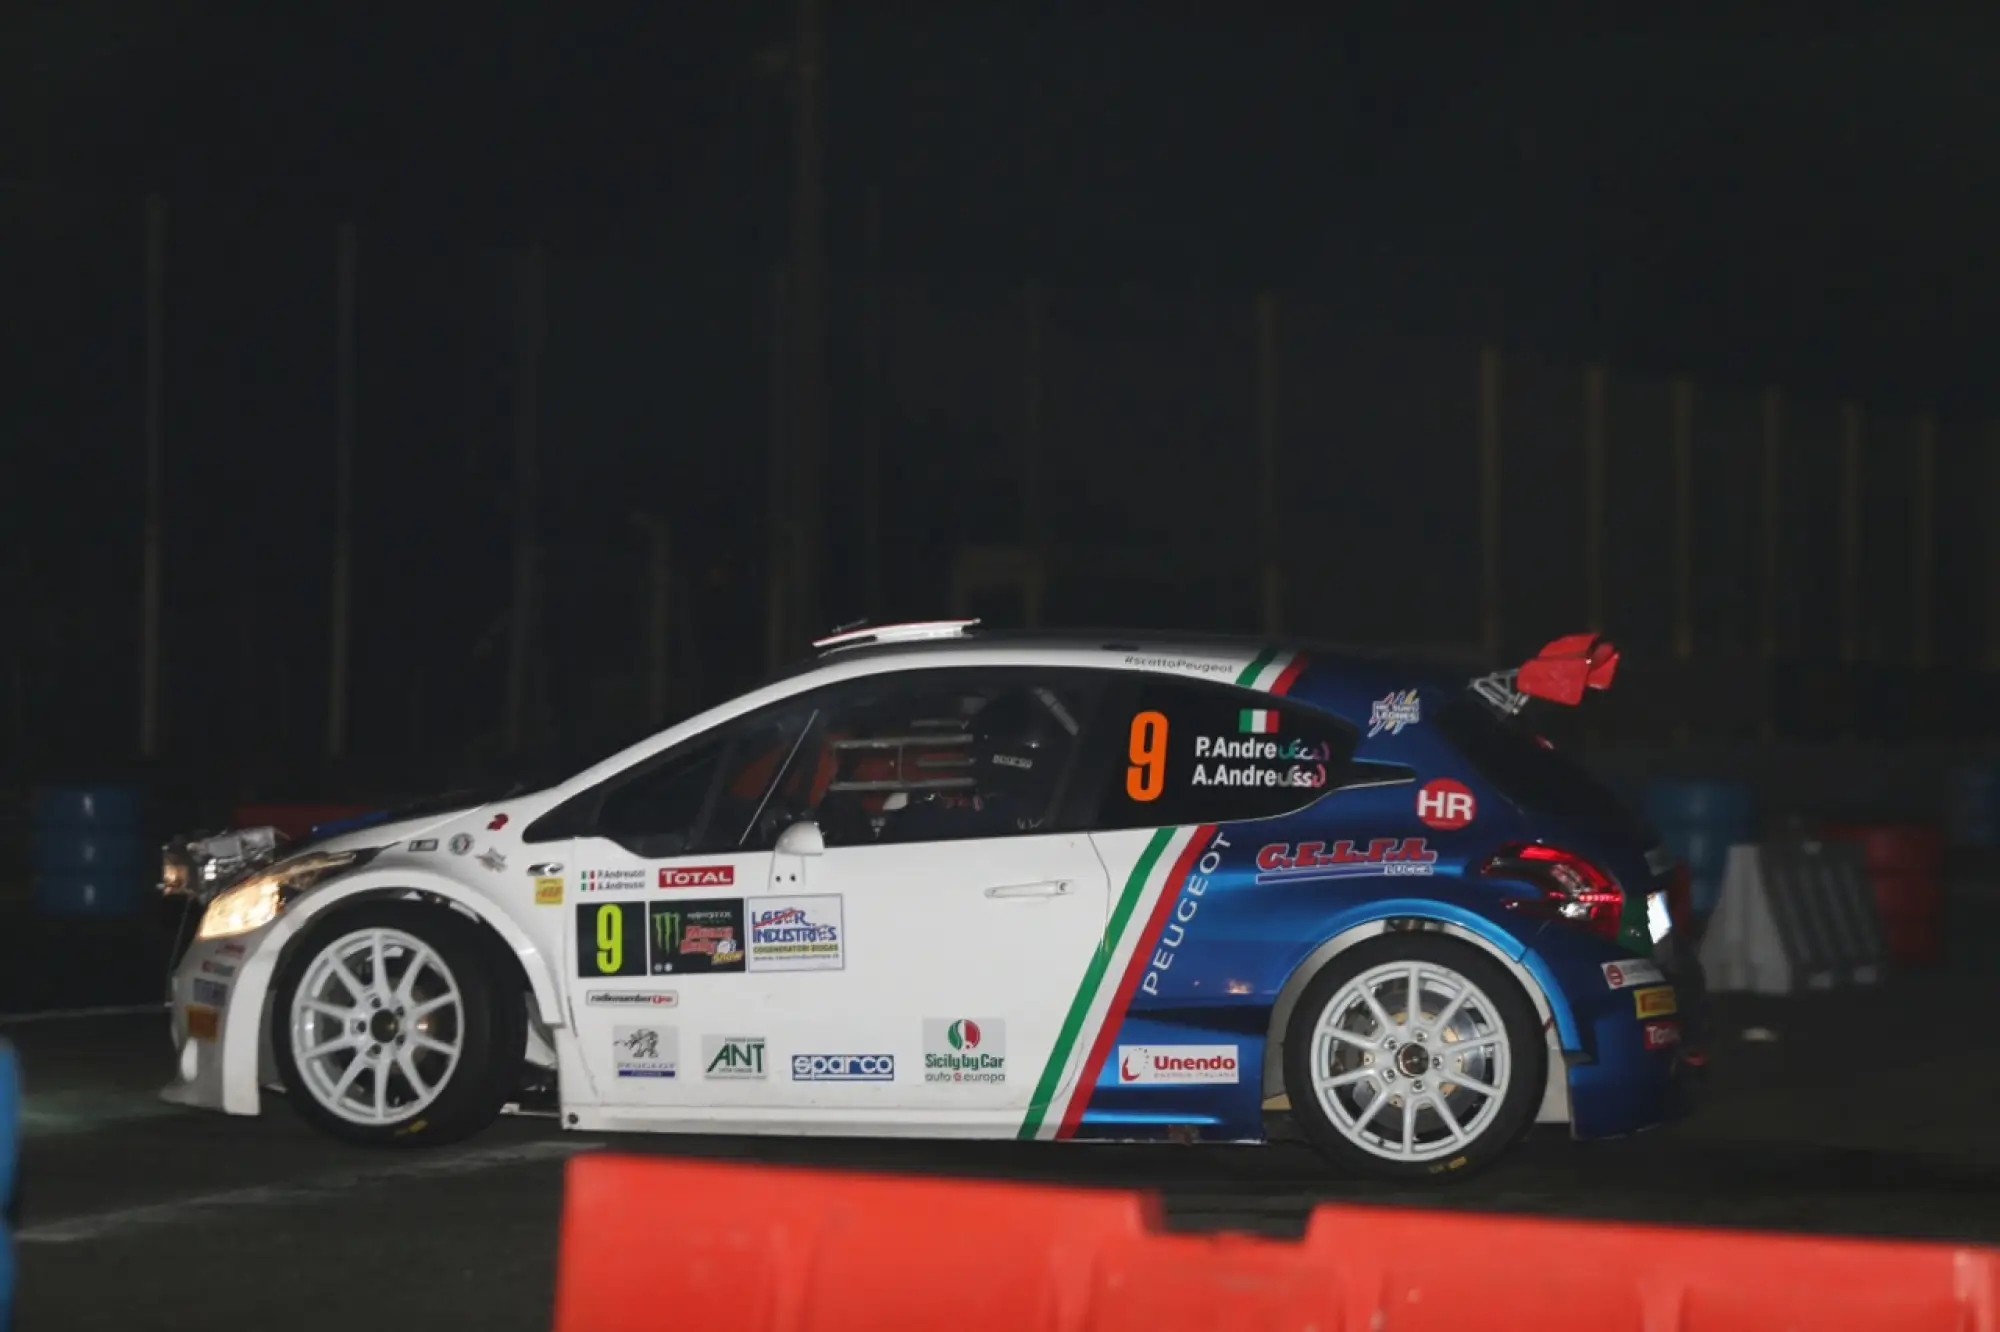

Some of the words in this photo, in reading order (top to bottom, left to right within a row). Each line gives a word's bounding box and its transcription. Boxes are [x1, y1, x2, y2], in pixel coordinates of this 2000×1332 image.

[1127, 711, 1169, 801] 9
[1417, 790, 1472, 820] HR
[661, 870, 732, 885] TOTAL
[1142, 832, 1231, 995] PEUGEOT
[597, 904, 623, 974] 9
[706, 1043, 765, 1073] ANT
[794, 1055, 893, 1080] sparco
[925, 1053, 960, 1071] Sicily
[961, 1053, 979, 1071] by
[980, 1053, 1005, 1068] Car
[1154, 1055, 1236, 1070] Unendo
[963, 1073, 1005, 1083] europa
